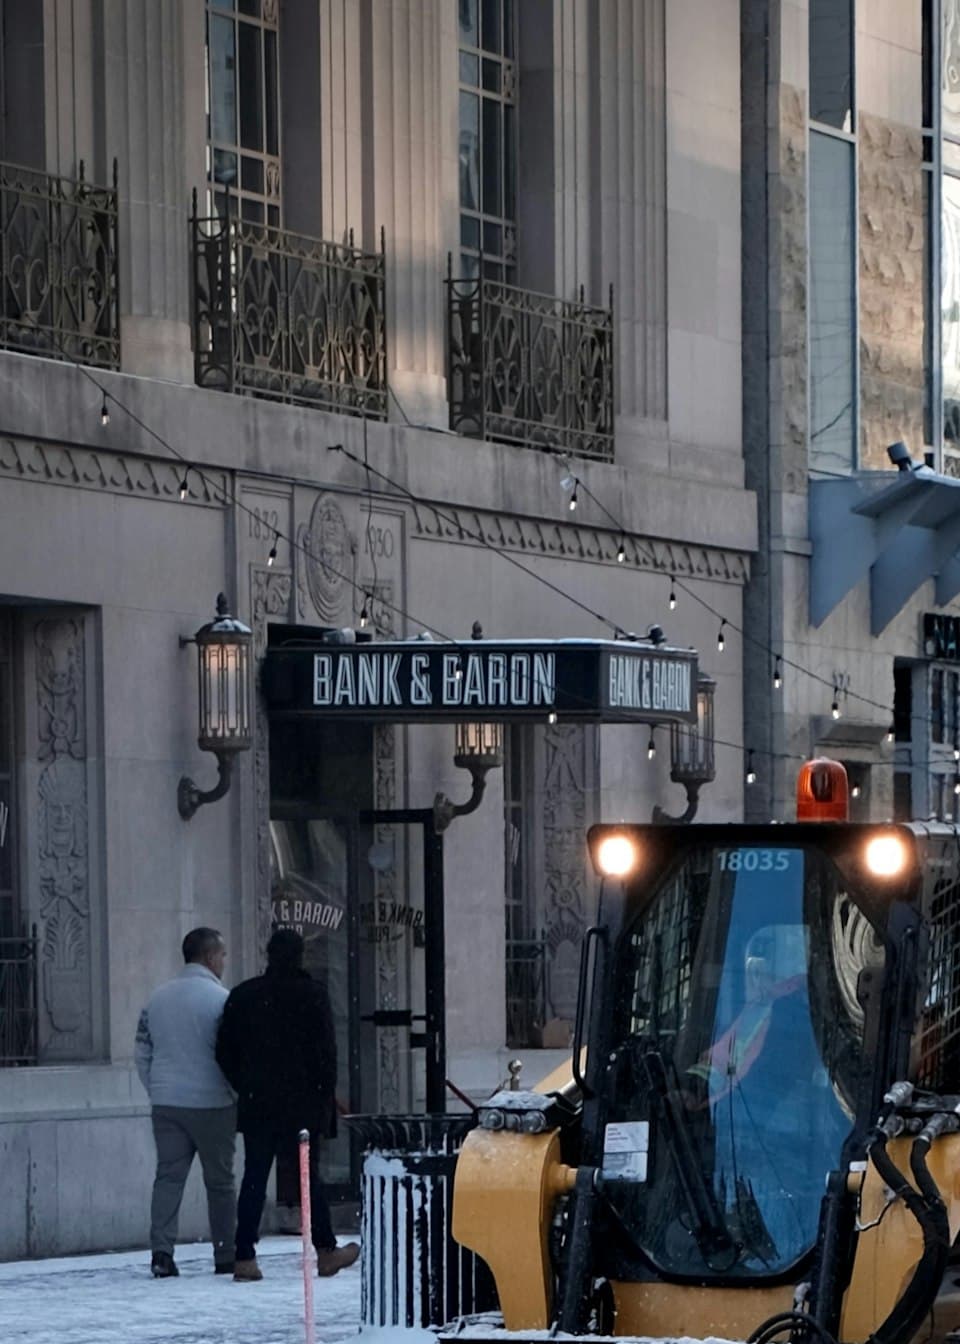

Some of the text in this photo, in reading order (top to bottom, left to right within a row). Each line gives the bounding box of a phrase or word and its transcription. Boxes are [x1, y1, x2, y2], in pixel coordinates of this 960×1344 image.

[313, 653, 556, 705] BANK & BARON
[609, 654, 691, 712] BANK & BARON
[716, 850, 790, 871] 18035
[294, 901, 343, 930] BARON
